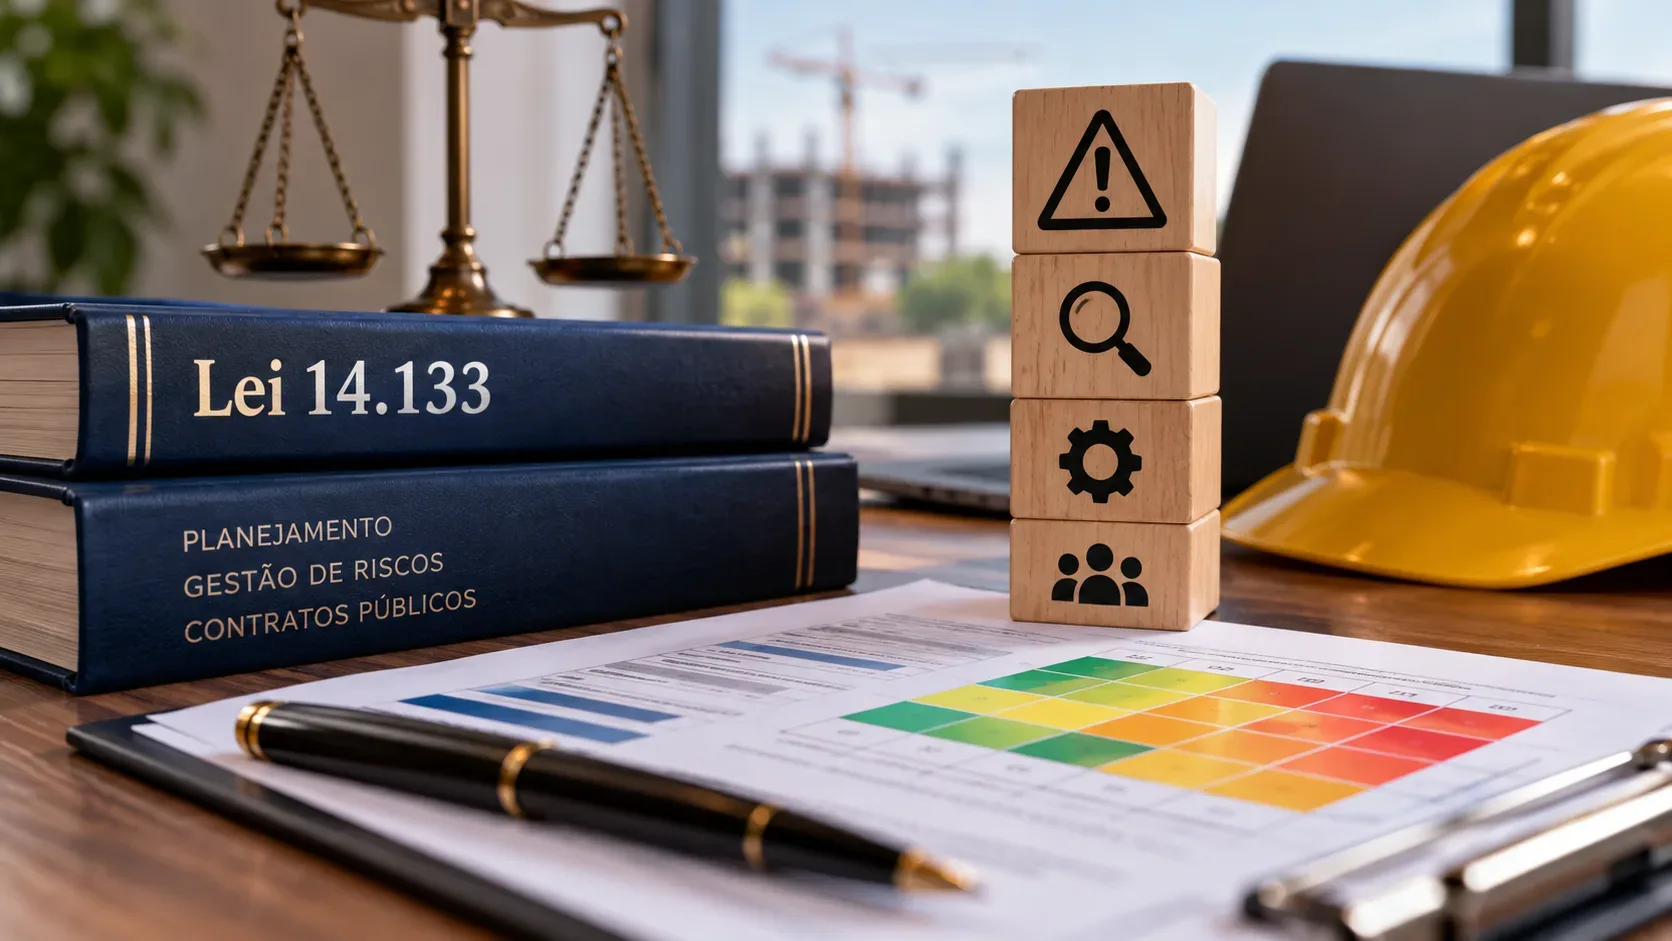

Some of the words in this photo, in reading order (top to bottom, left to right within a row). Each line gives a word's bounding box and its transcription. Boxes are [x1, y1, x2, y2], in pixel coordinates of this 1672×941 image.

[193, 358, 286, 417] Lei
[305, 358, 492, 416] 14.133
[183, 515, 393, 553] PLANEJAMENTO
[183, 562, 298, 599] GESTÃO
[309, 561, 344, 587] DE
[354, 551, 445, 582] RISCOS
[184, 603, 350, 645] CONTRATOS
[359, 588, 478, 623] PÚBLICOS
